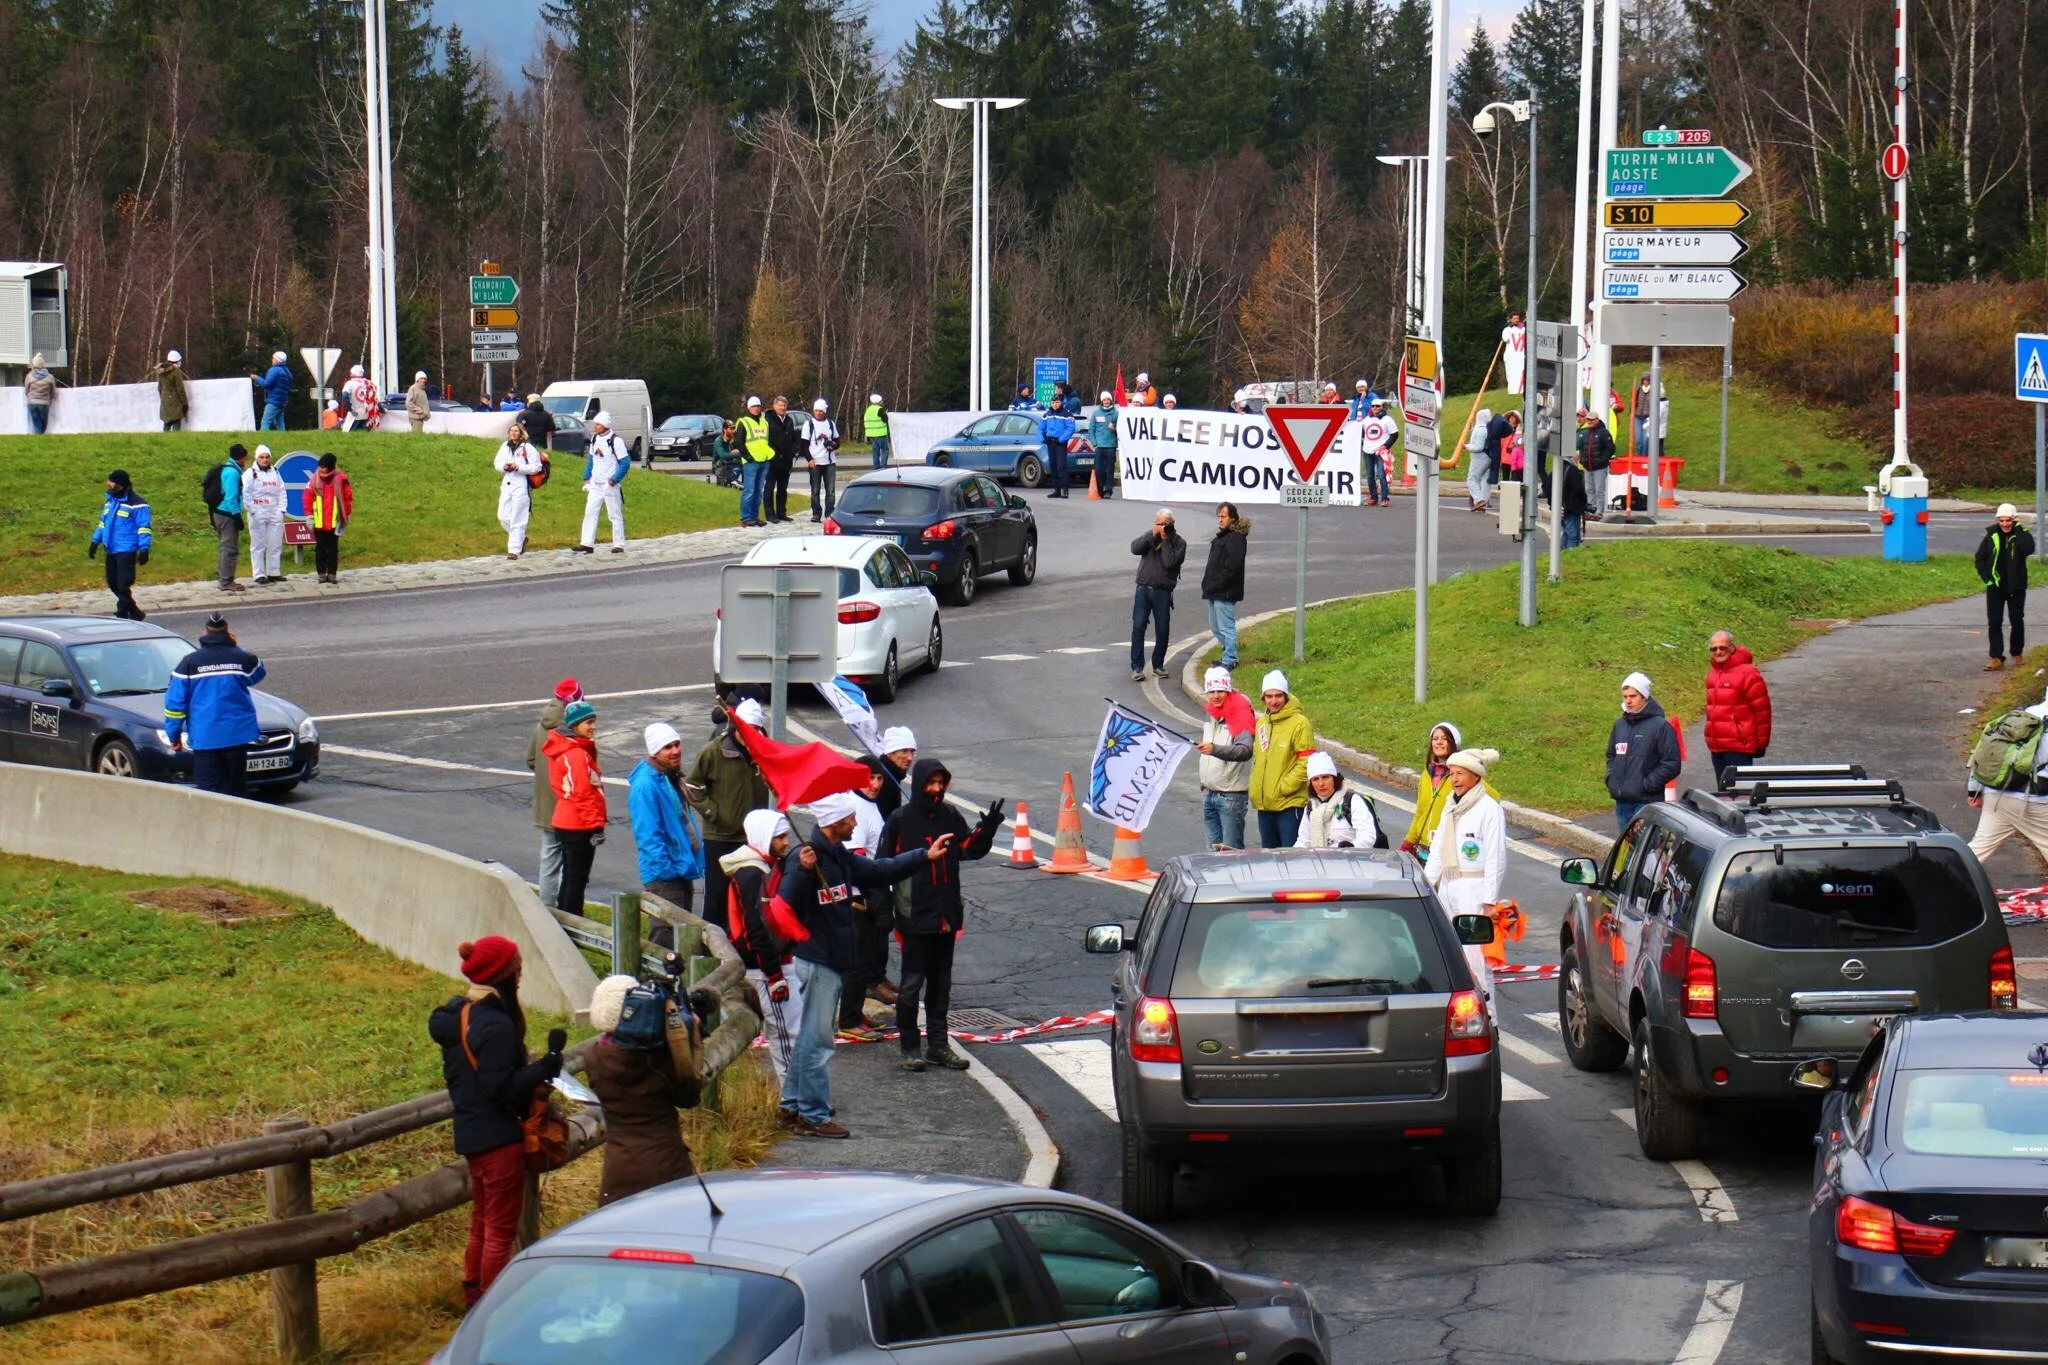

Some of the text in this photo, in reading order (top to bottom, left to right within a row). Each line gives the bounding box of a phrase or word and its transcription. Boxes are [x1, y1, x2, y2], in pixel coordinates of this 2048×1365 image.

[1646, 133, 1672, 142] E 25
[1612, 152, 1715, 166] TURIN-MILAN
[1611, 168, 1659, 181] AOSTE
[1614, 182, 1644, 193] péage
[1608, 237, 1701, 247] COURMAYEUR
[1610, 249, 1638, 258] péage
[1607, 273, 1649, 283] TUNNEL
[1687, 273, 1724, 283] BLANC
[473, 280, 506, 290] CHAMONIX
[1609, 285, 1637, 295] péage
[483, 291, 503, 300] BLANC
[474, 351, 508, 360] VALLORCINE
[1126, 416, 1211, 445] VALLEE
[1124, 456, 1153, 481] AUX
[1315, 488, 1324, 496] LE
[1286, 496, 1323, 504] PASSAGE
[197, 663, 243, 673] GENDARMERIE
[1835, 883, 1874, 894] kern
